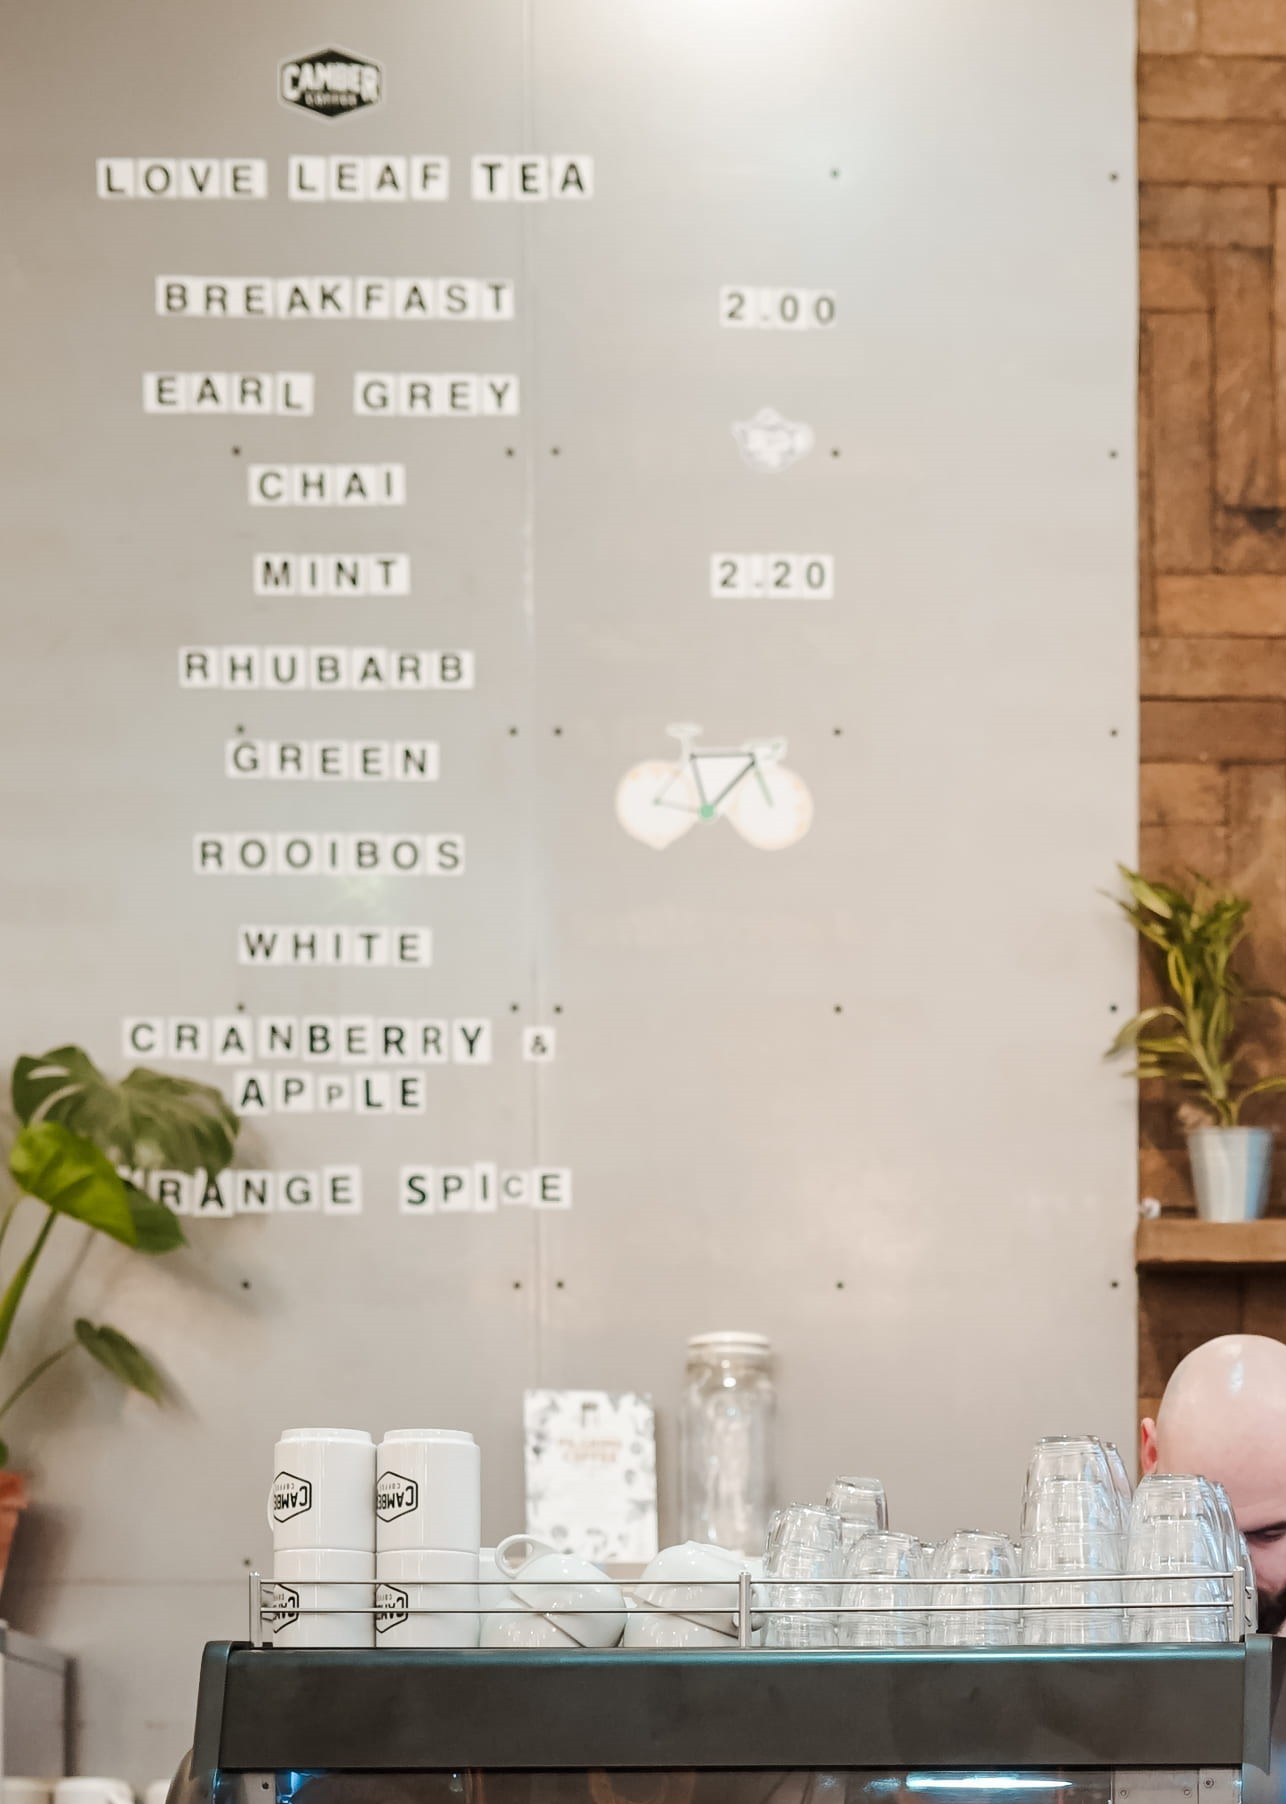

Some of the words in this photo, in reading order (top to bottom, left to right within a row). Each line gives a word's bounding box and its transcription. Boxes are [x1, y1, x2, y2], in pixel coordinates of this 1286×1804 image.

[106, 165, 251, 195] LOVE
[298, 164, 441, 191] LEAF
[482, 163, 583, 192] TEA
[166, 284, 507, 315] BREAKFAST
[726, 292, 836, 323] 2.00
[157, 376, 300, 409] EARL
[363, 381, 509, 410] GREY
[259, 472, 391, 500] CHAI
[264, 561, 398, 586] MINT
[720, 560, 825, 589] 2.20
[186, 653, 462, 683] RHUBARB
[233, 742, 427, 774] GREEN
[201, 839, 459, 870] ROOIBOS
[245, 933, 421, 961] WHITE
[131, 1024, 481, 1055] CRANBERRY
[530, 1034, 549, 1055] &
[124, 1174, 353, 1207] RANGE
